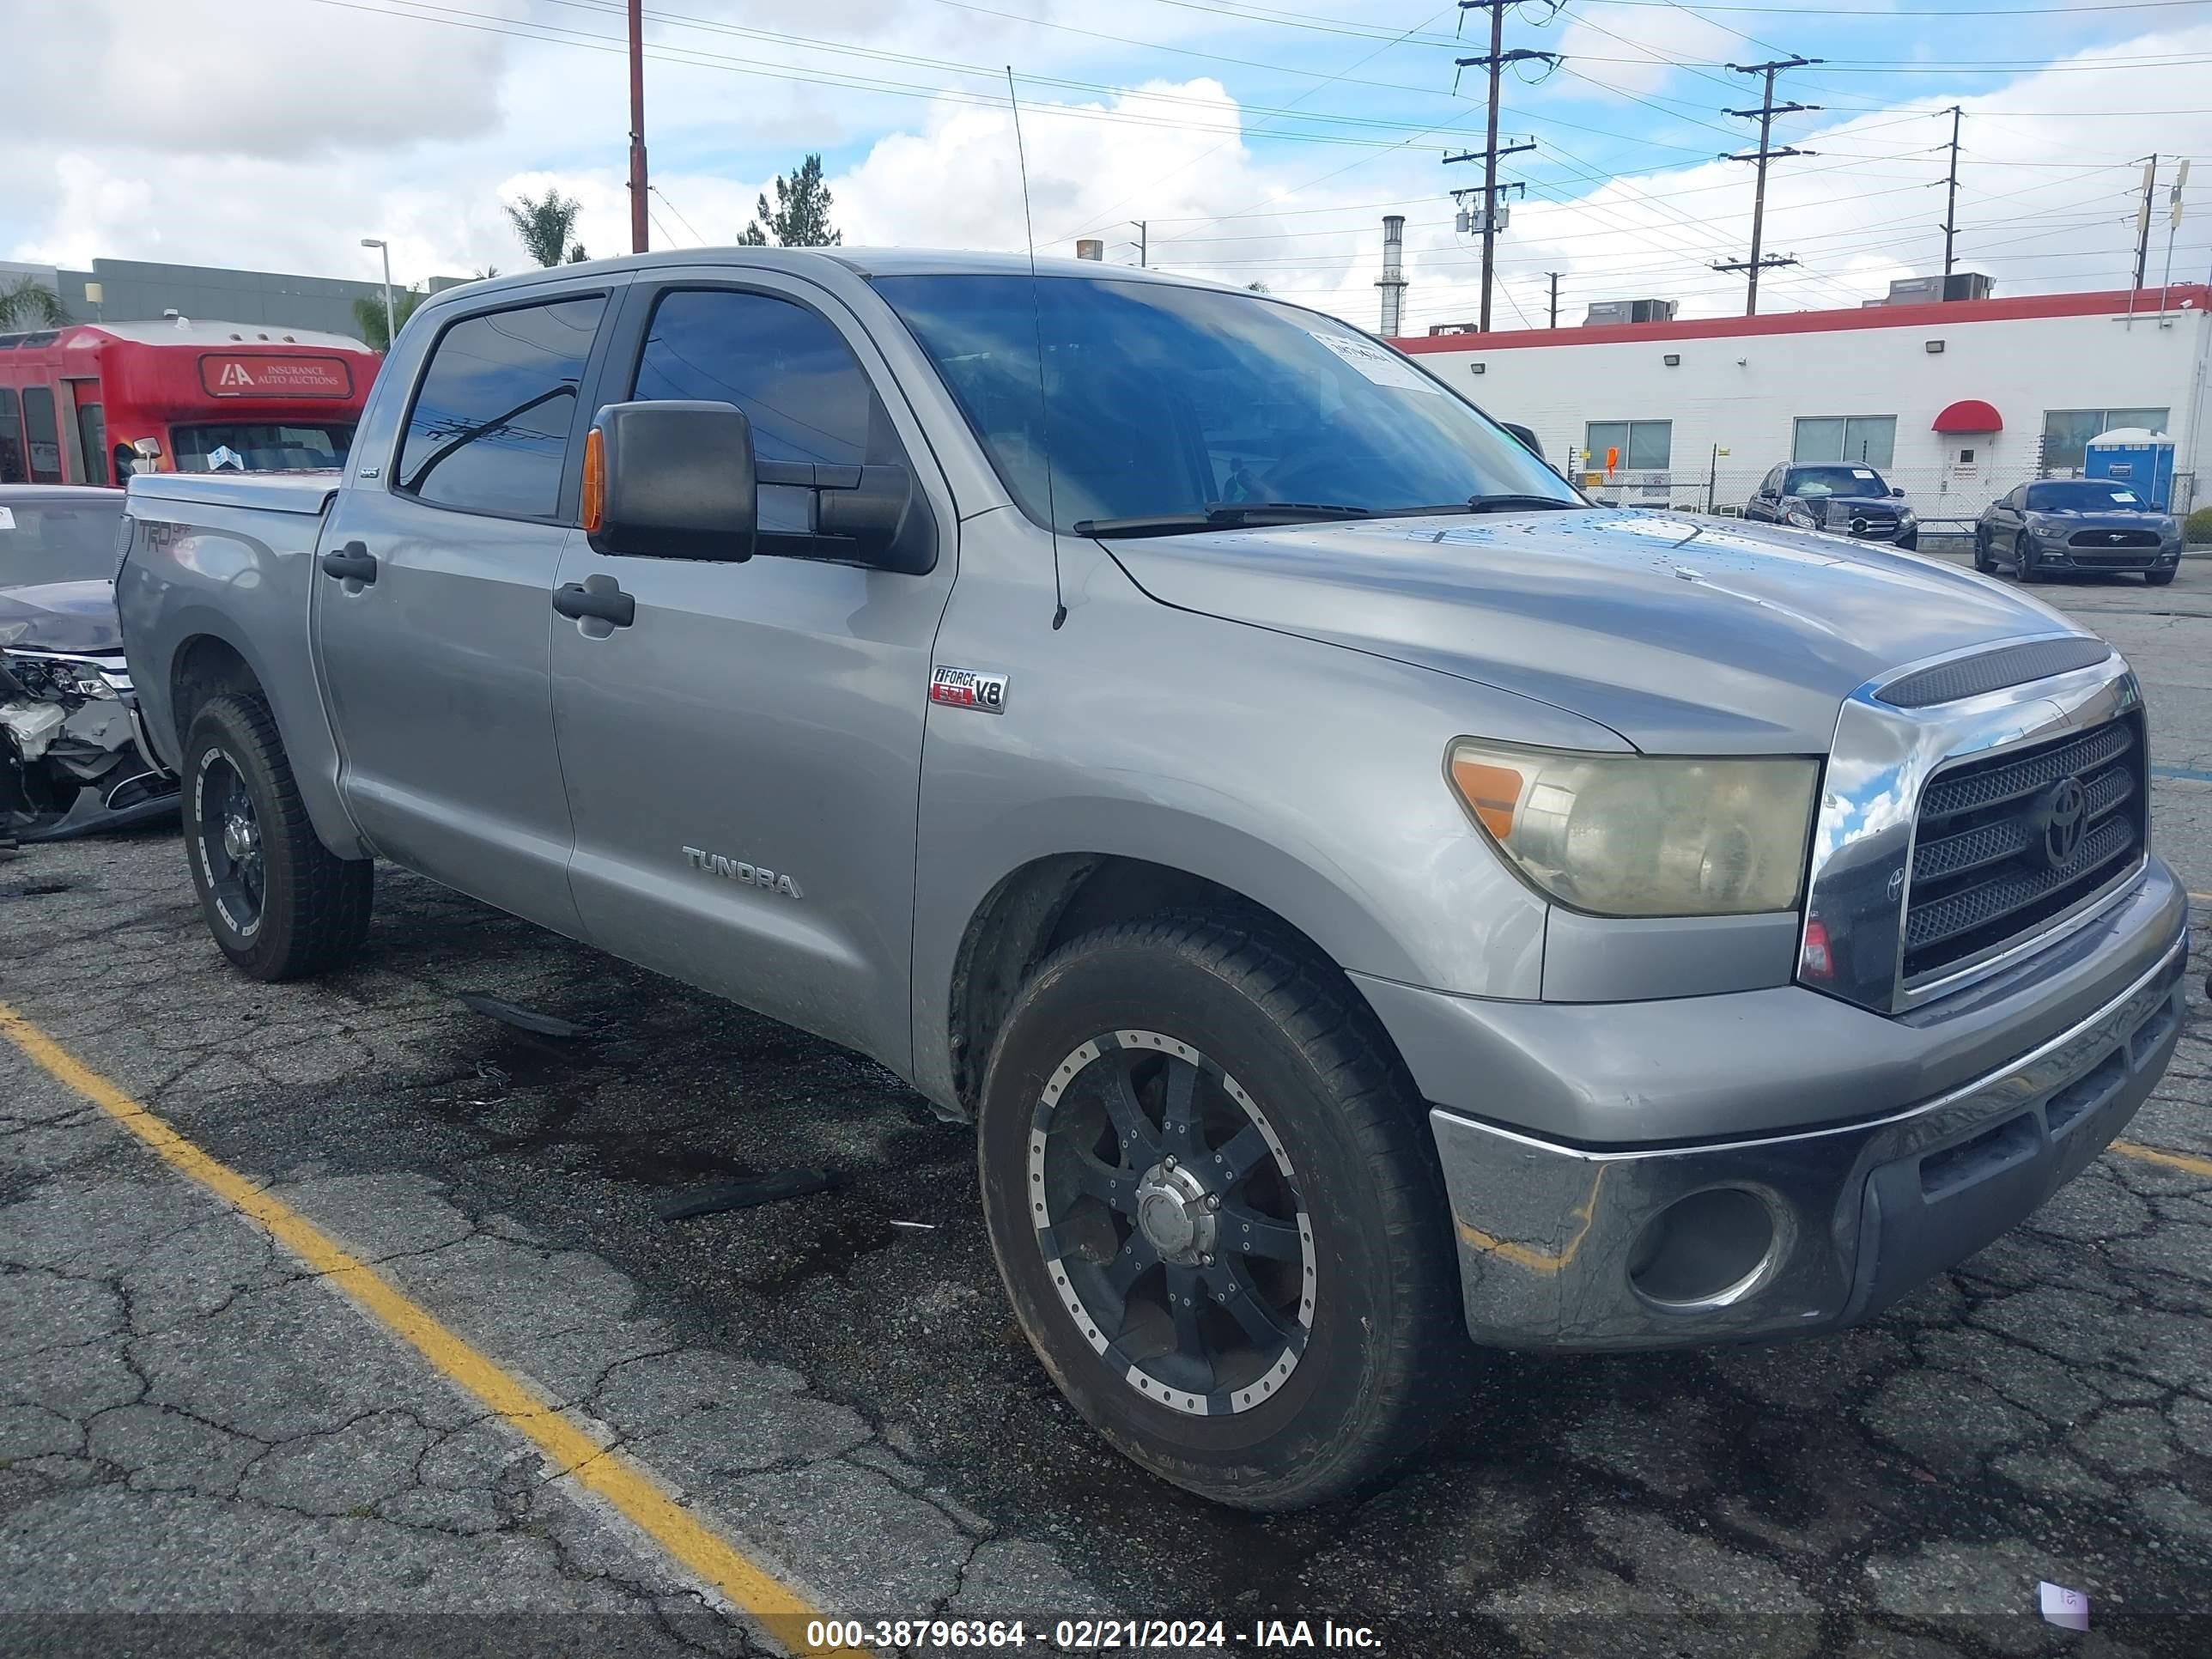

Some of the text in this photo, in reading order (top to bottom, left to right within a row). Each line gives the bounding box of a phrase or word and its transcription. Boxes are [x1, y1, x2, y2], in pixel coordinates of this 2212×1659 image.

[258, 376, 338, 386] AUTO AUCTIONS
[268, 366, 324, 376] INSURANCE
[139, 520, 171, 553] TRD
[975, 679, 1001, 705] V8
[683, 846, 803, 899] TUNDRA
